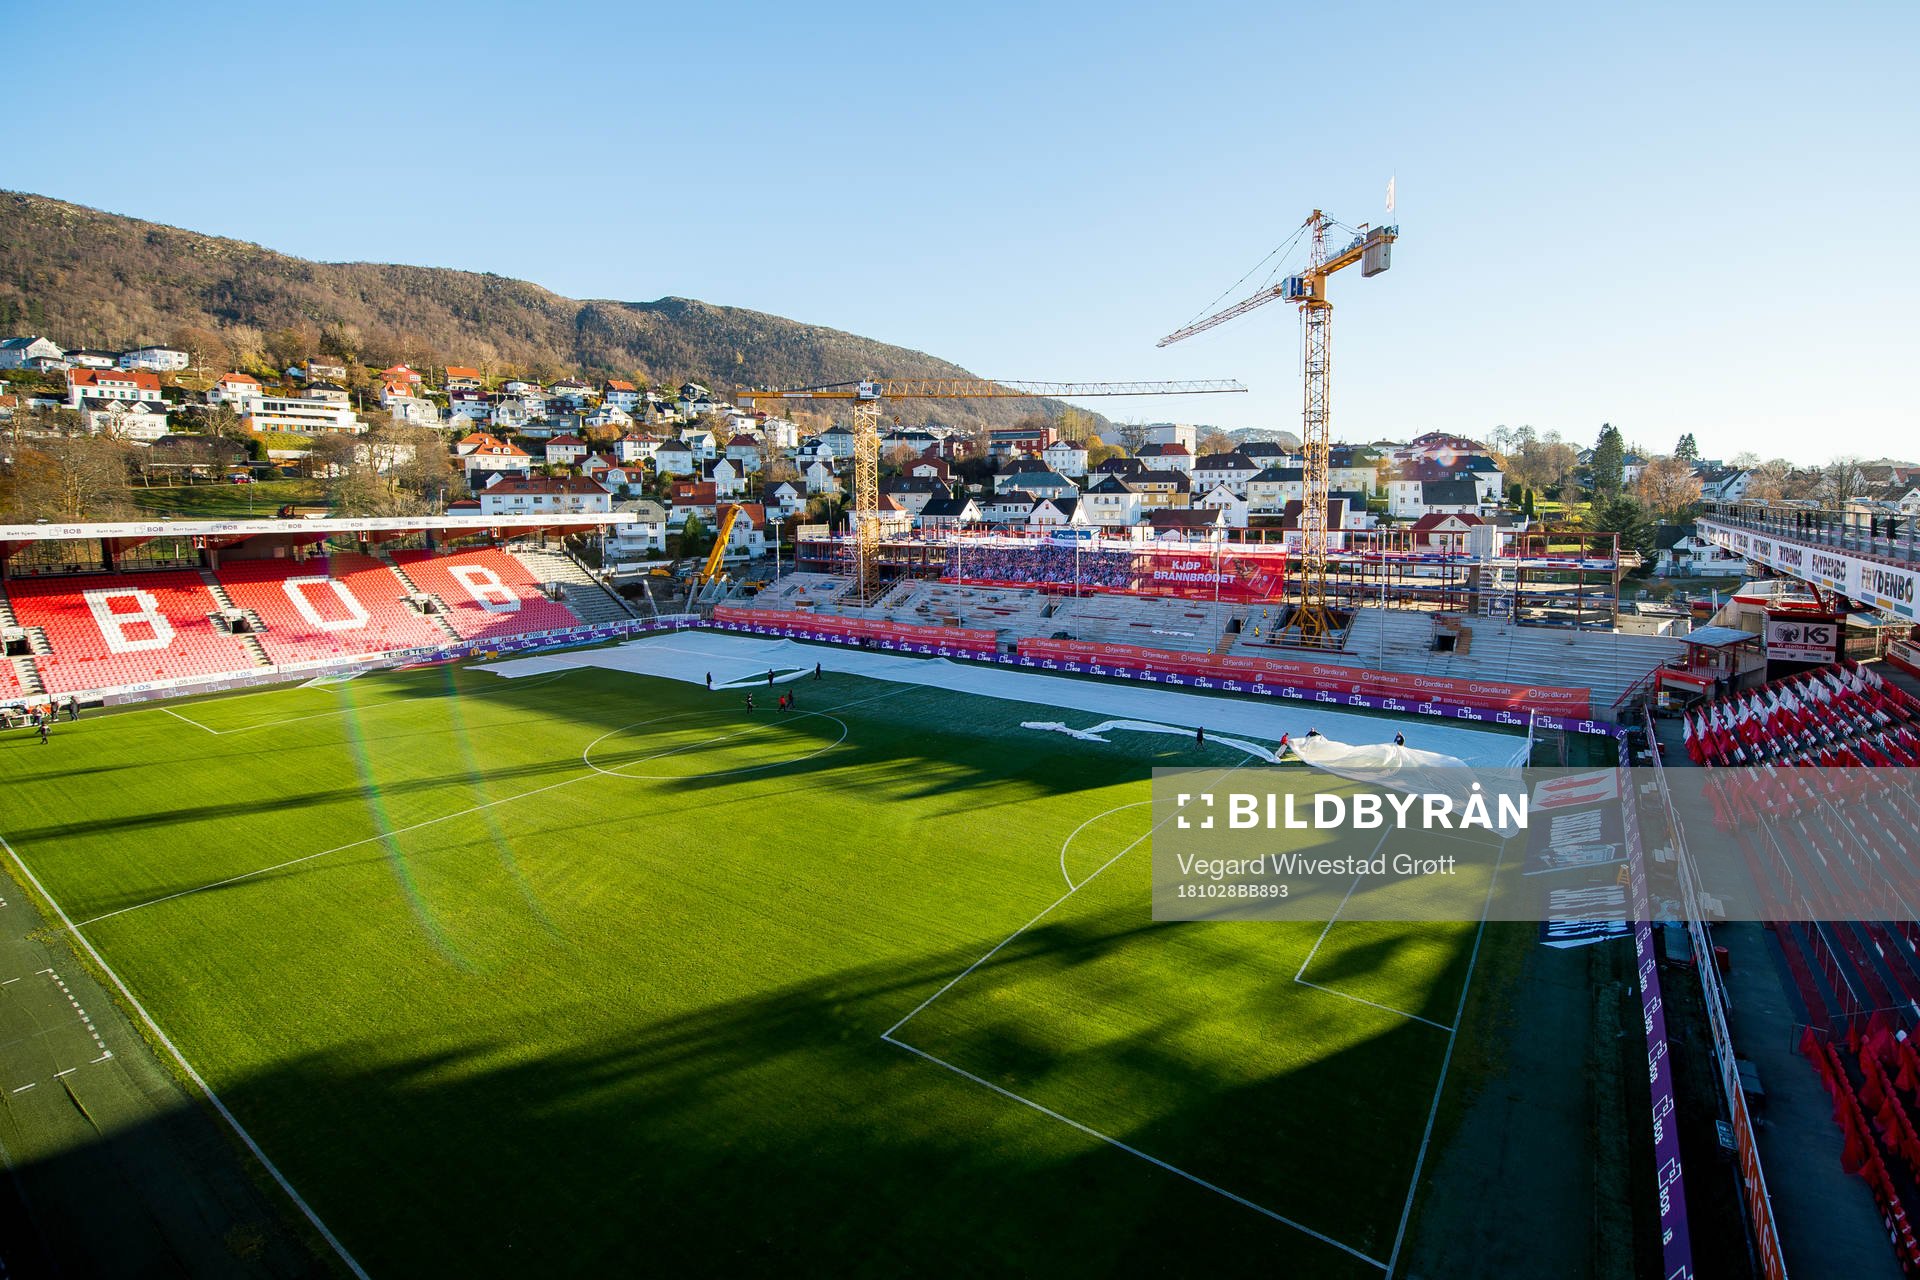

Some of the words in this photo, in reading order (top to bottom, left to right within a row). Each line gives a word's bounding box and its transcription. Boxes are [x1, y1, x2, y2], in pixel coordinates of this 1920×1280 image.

[1172, 560, 1200, 570] KJØP
[1812, 554, 1846, 581] FRYDENBØ
[1154, 571, 1236, 583] BRANNBRØDET
[1862, 566, 1914, 604] FRYDENBØ
[82, 586, 176, 655] B
[447, 564, 521, 614] B
[1804, 626, 1829, 644] KS
[382, 650, 410, 658] TESS
[412, 646, 439, 655] TESS
[1273, 663, 1300, 671] Fjordkraft
[1320, 668, 1348, 677] Fjordkraft
[1369, 674, 1399, 683] Fjordkraft
[1423, 680, 1453, 689] Fjordkraft
[1478, 686, 1511, 695] Fjordkraft
[1538, 691, 1572, 699] Fjordkraft
[1645, 1015, 1653, 1035] BOB
[1649, 1063, 1658, 1083] BOB
[1654, 1118, 1663, 1145] BOB
[1659, 1186, 1670, 1217] BOB
